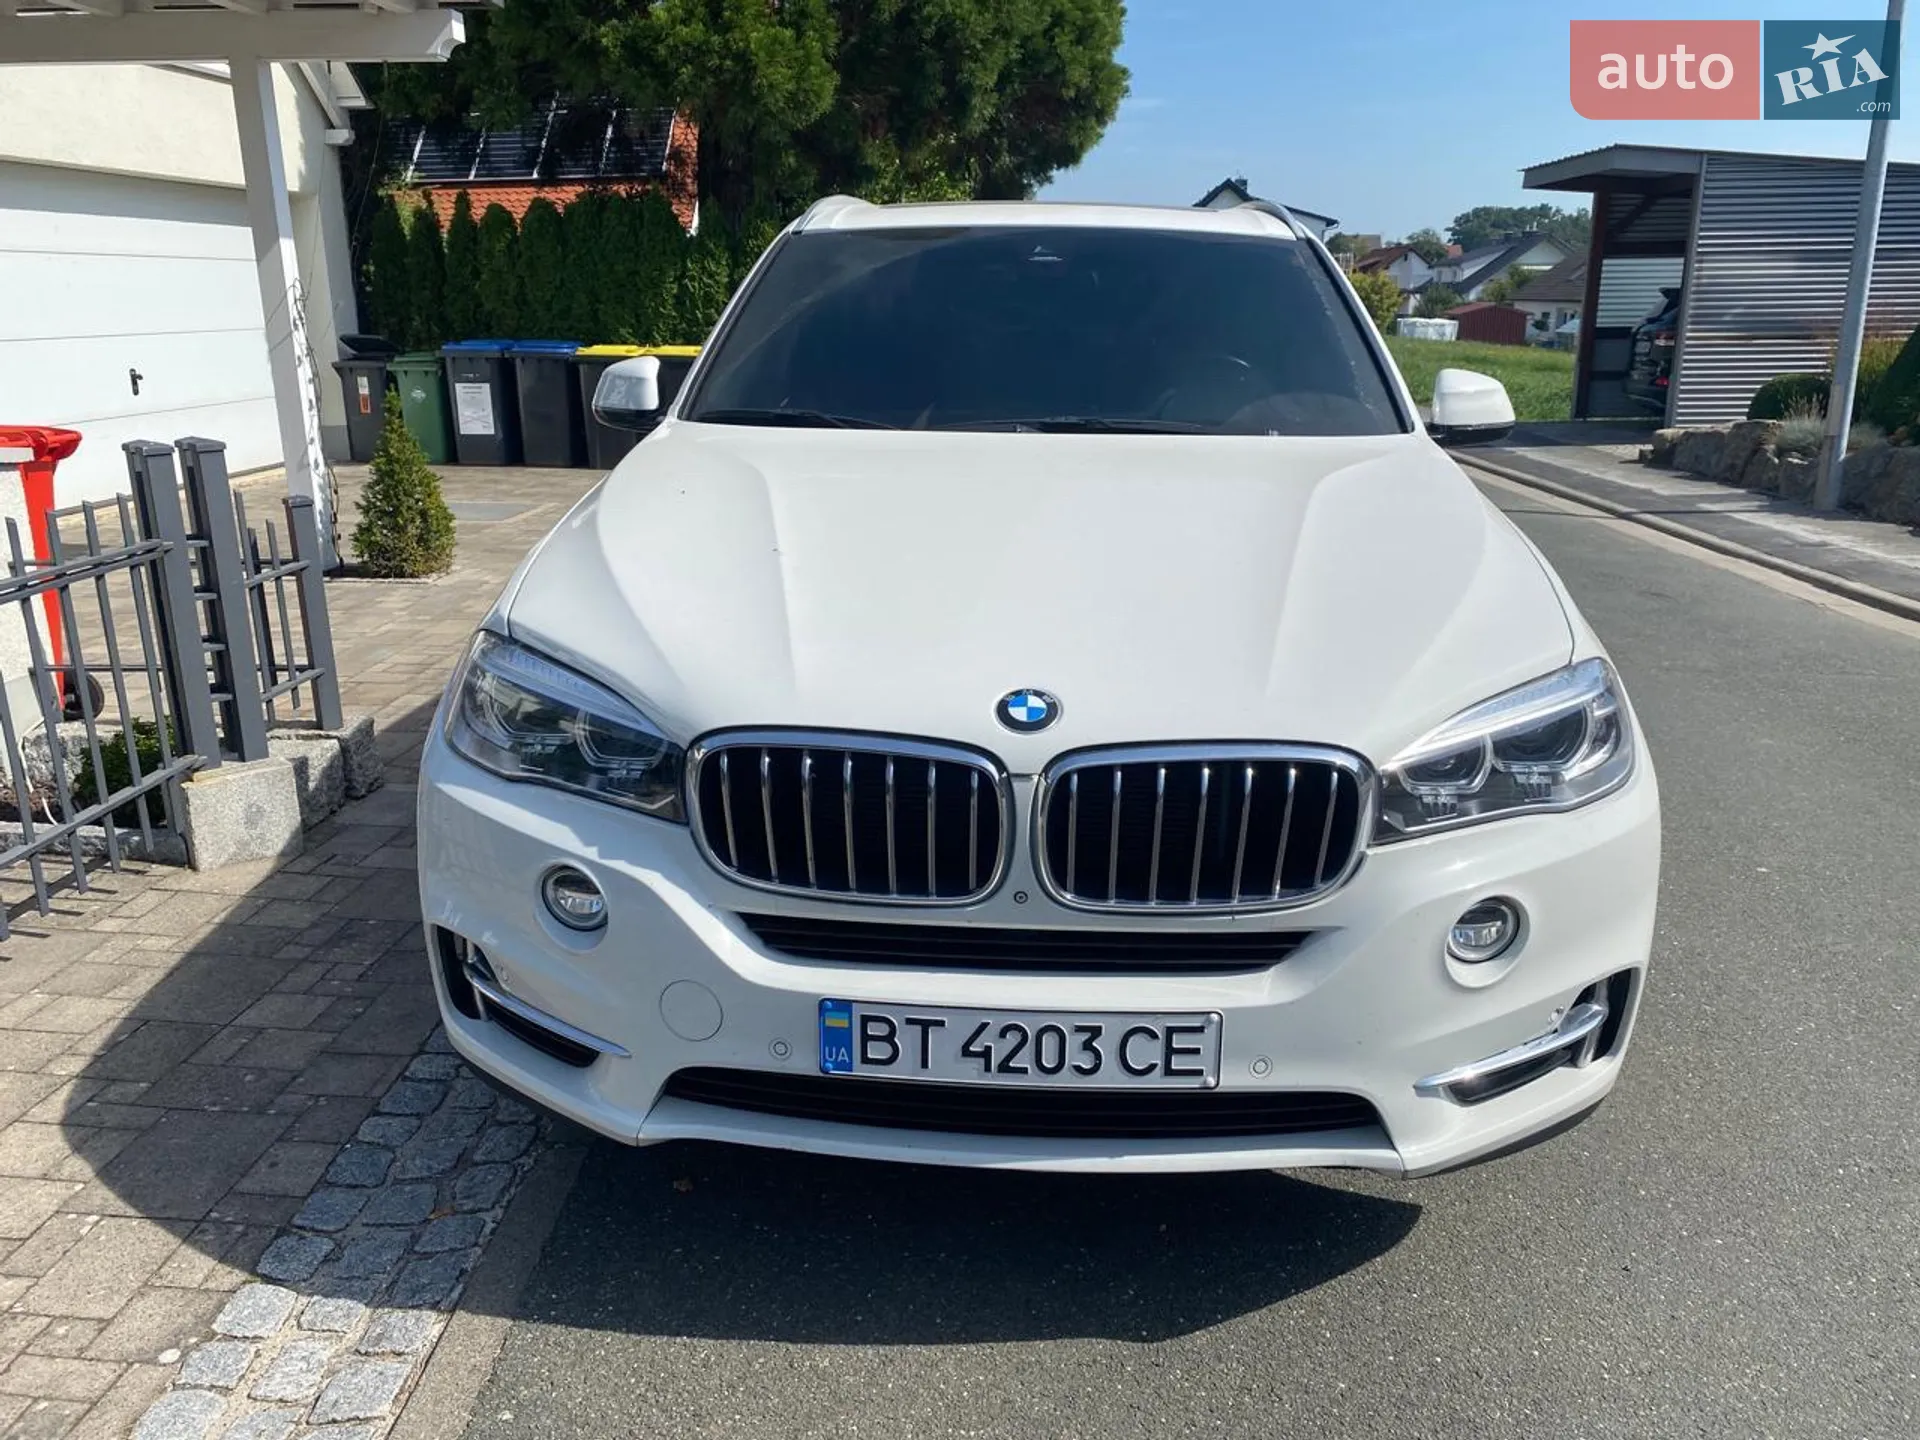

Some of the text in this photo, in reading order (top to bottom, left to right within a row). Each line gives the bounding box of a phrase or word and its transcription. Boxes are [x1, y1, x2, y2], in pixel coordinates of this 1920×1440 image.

[825, 1046, 849, 1063] UA
[860, 1013, 1206, 1077] BT 4203 CE
